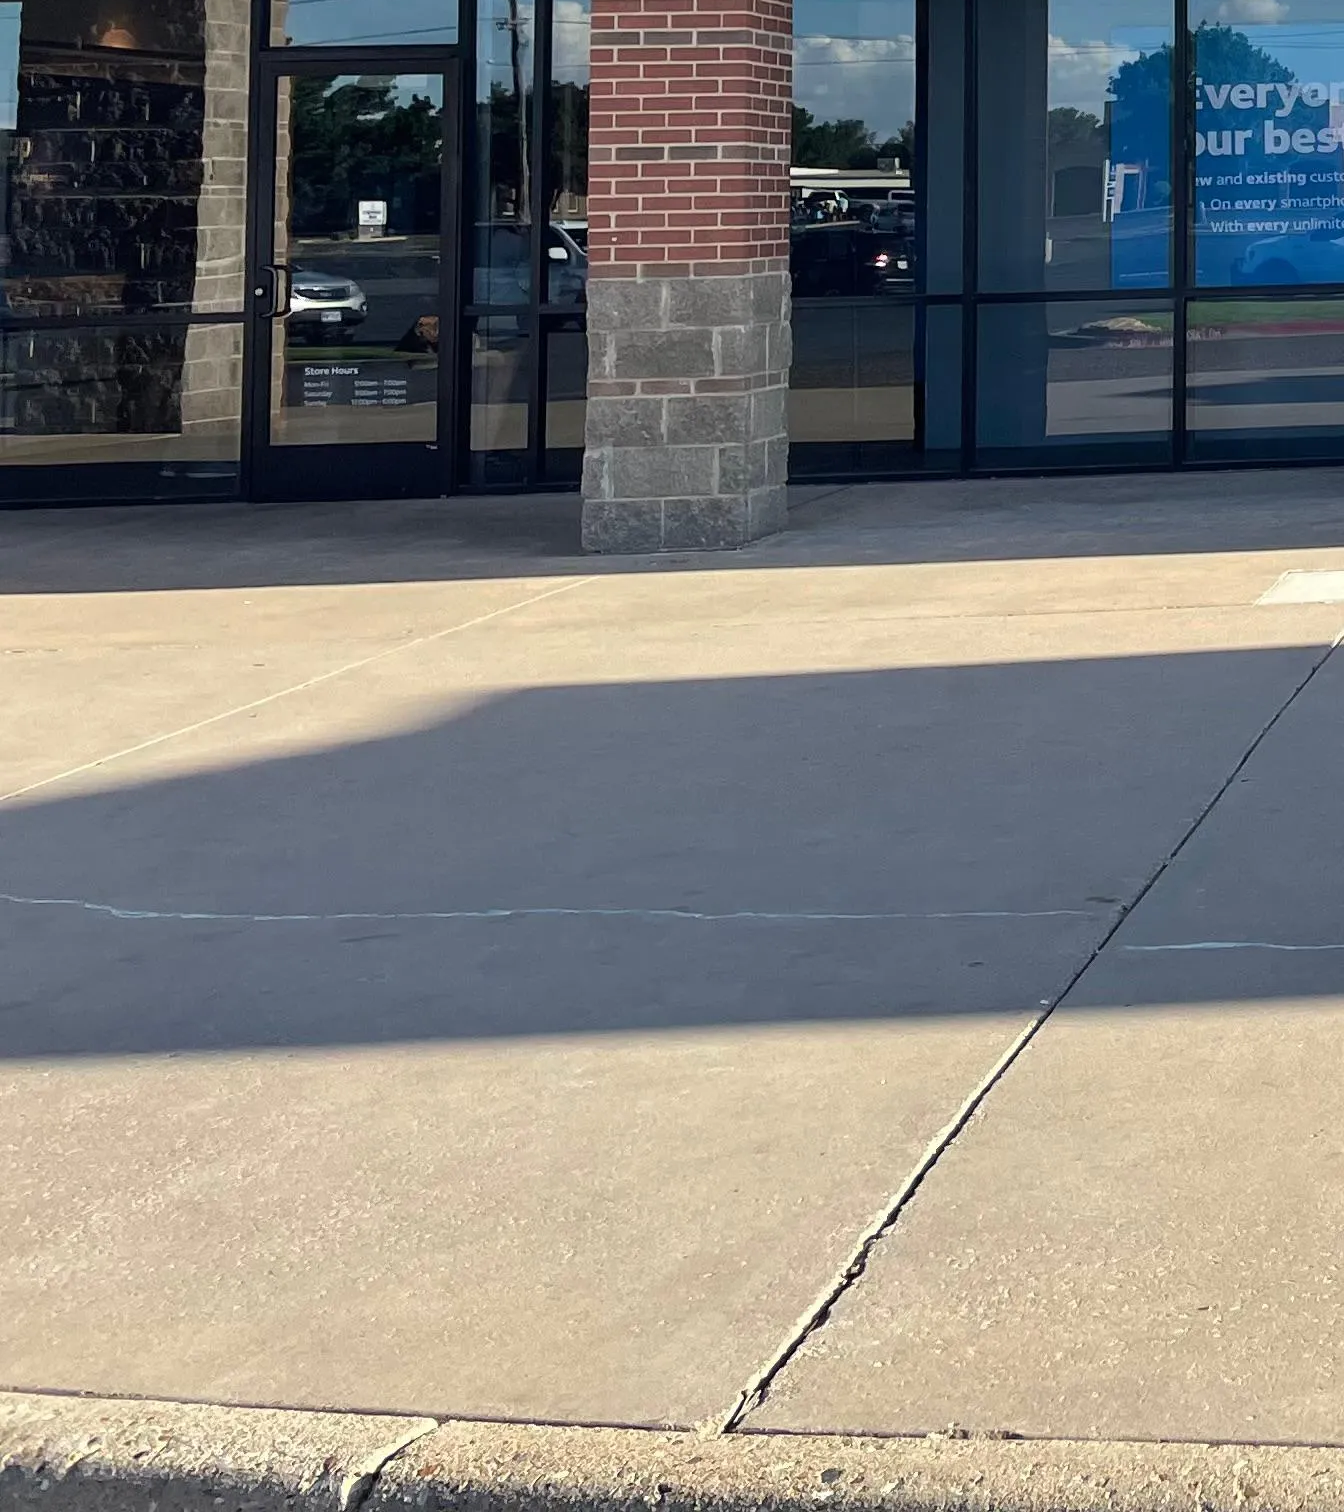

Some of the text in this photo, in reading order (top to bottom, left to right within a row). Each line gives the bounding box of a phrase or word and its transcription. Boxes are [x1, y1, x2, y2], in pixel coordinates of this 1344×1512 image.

[1216, 171, 1243, 185] and
[1246, 170, 1307, 186] existing
[1210, 198, 1231, 211] On
[1234, 198, 1277, 212] every
[1211, 220, 1244, 233] With
[1247, 220, 1290, 234] every
[304, 367, 359, 376] Store Hours
